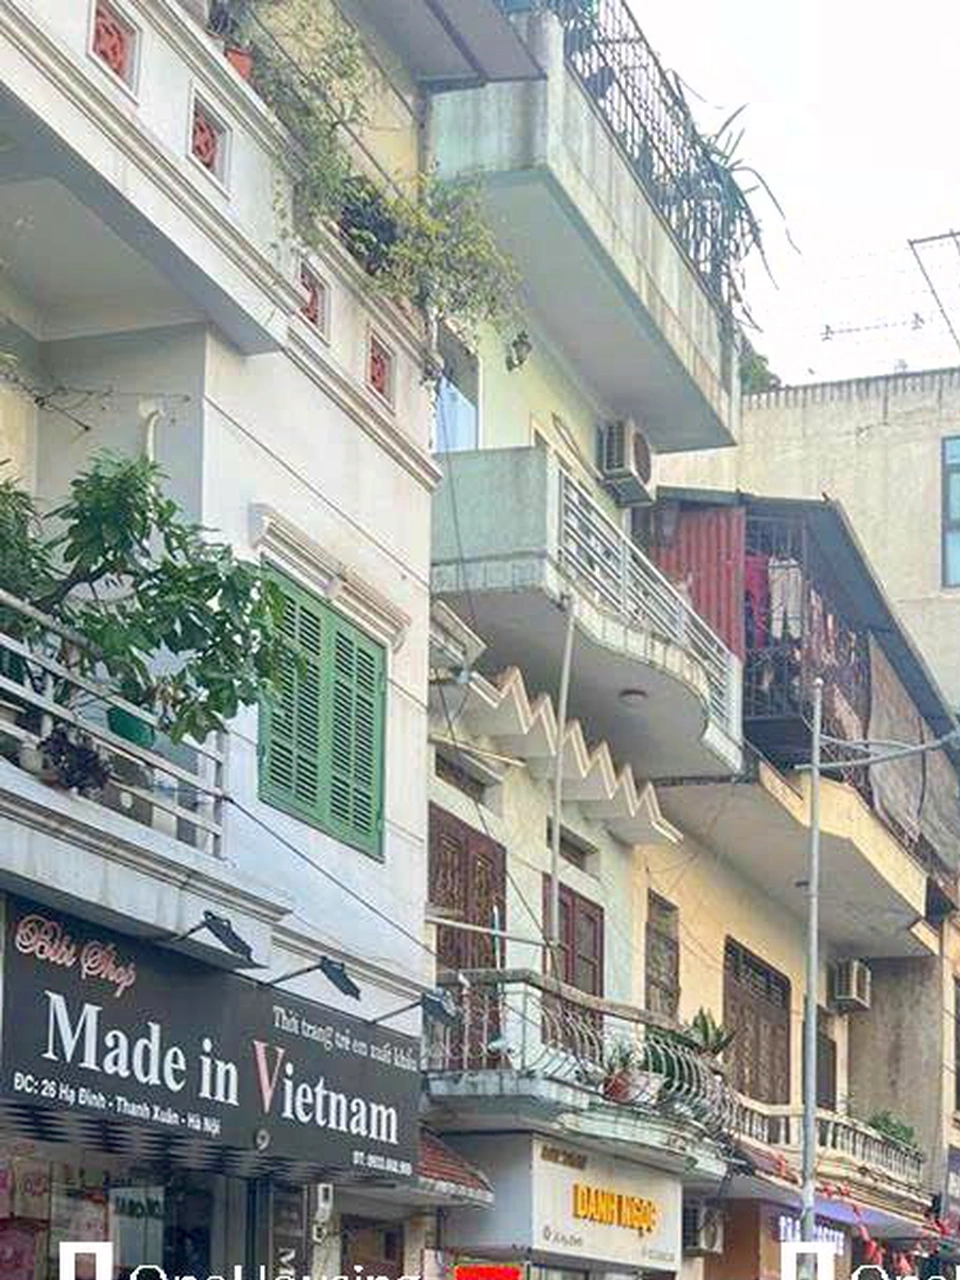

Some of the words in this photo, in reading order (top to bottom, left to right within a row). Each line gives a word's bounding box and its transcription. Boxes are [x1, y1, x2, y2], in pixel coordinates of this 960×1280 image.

[13, 1072, 39, 1095] ĐC:
[41, 1078, 57, 1099] 26
[59, 1083, 75, 1105] Hạ
[41, 990, 187, 1092] Made
[199, 1038, 239, 1107] in
[252, 1040, 400, 1145] Vietnam
